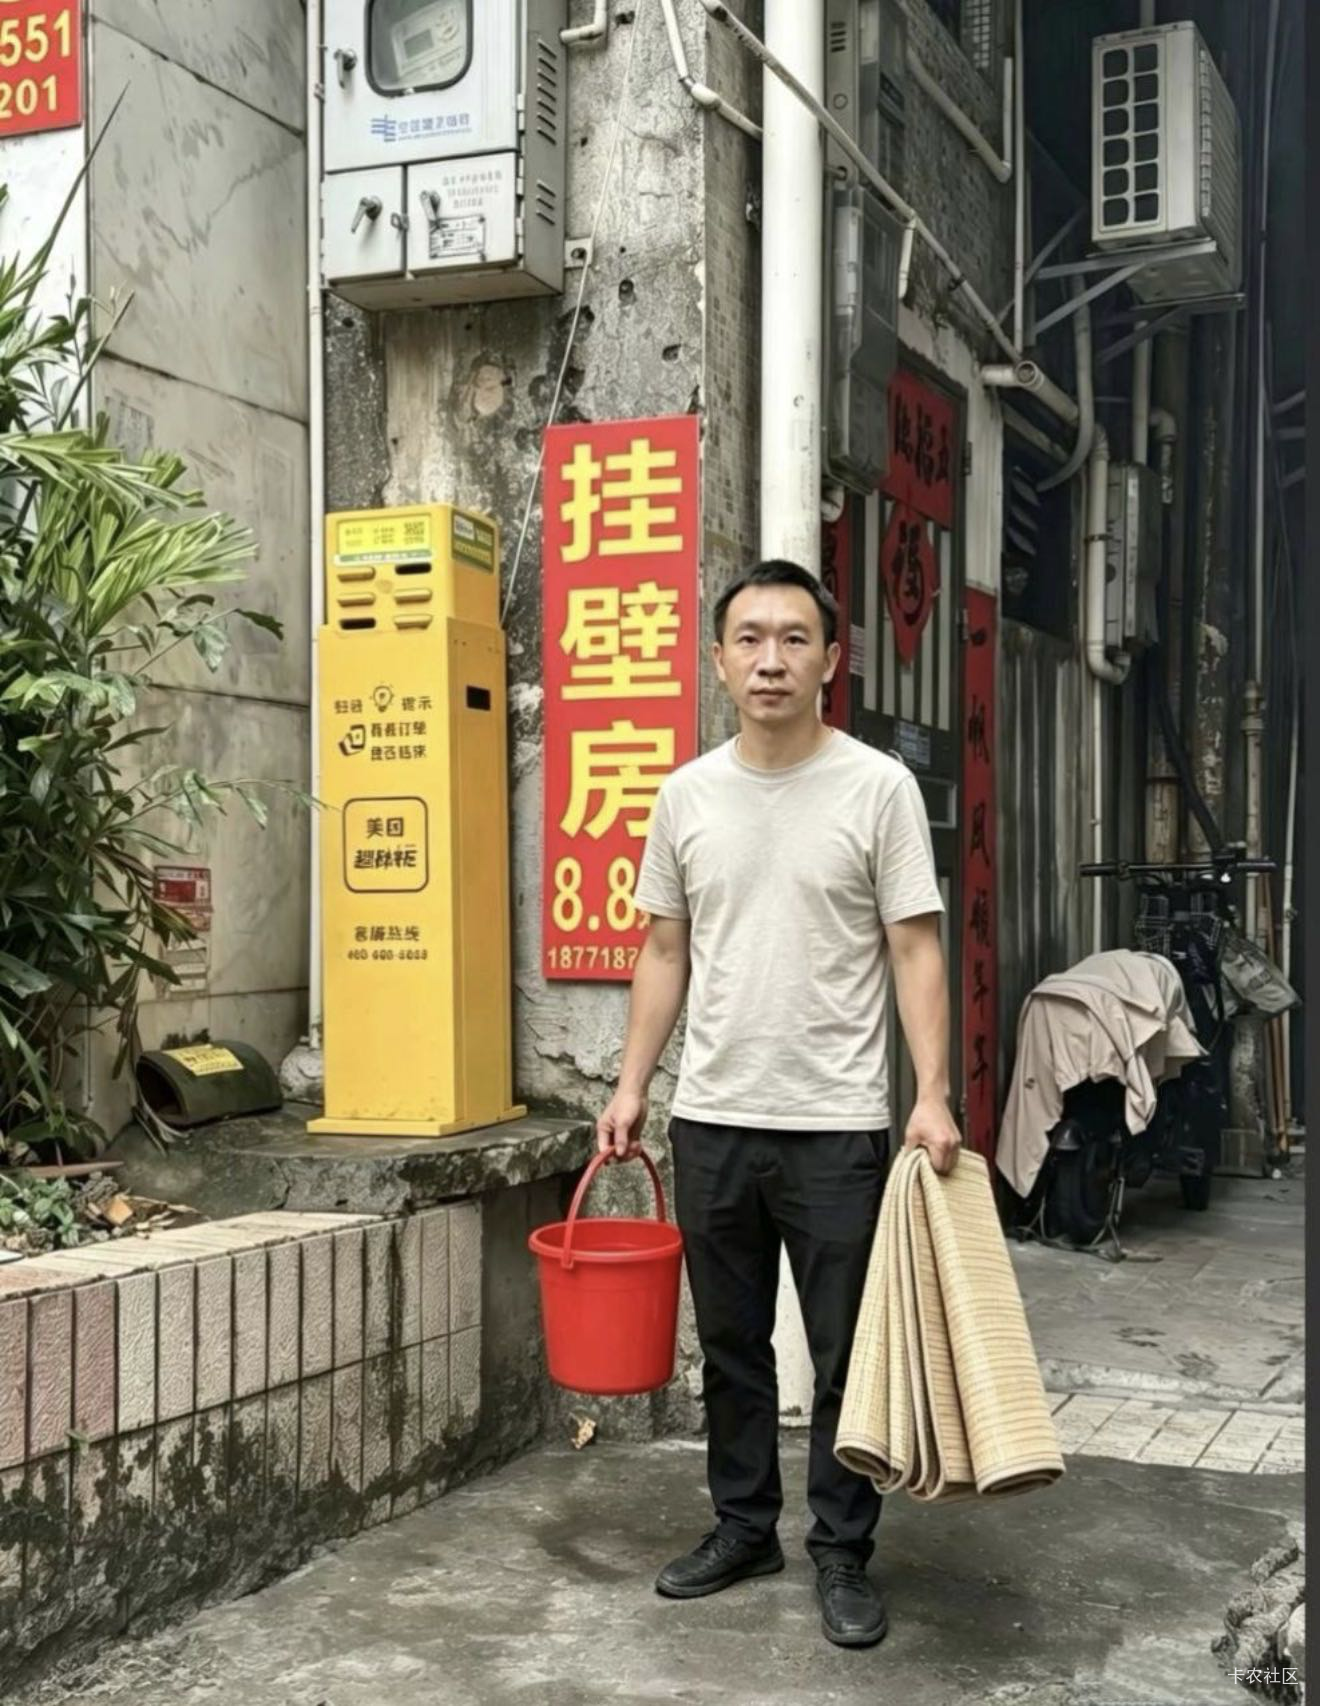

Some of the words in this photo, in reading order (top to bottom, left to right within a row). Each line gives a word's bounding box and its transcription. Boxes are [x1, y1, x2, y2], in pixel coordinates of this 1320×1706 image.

[0, 9, 71, 67] 551
[0, 74, 57, 119] 201
[559, 438, 683, 840] 挂壁房
[552, 856, 651, 932] 8.8
[966, 627, 990, 1148] 一帆风顺年年
